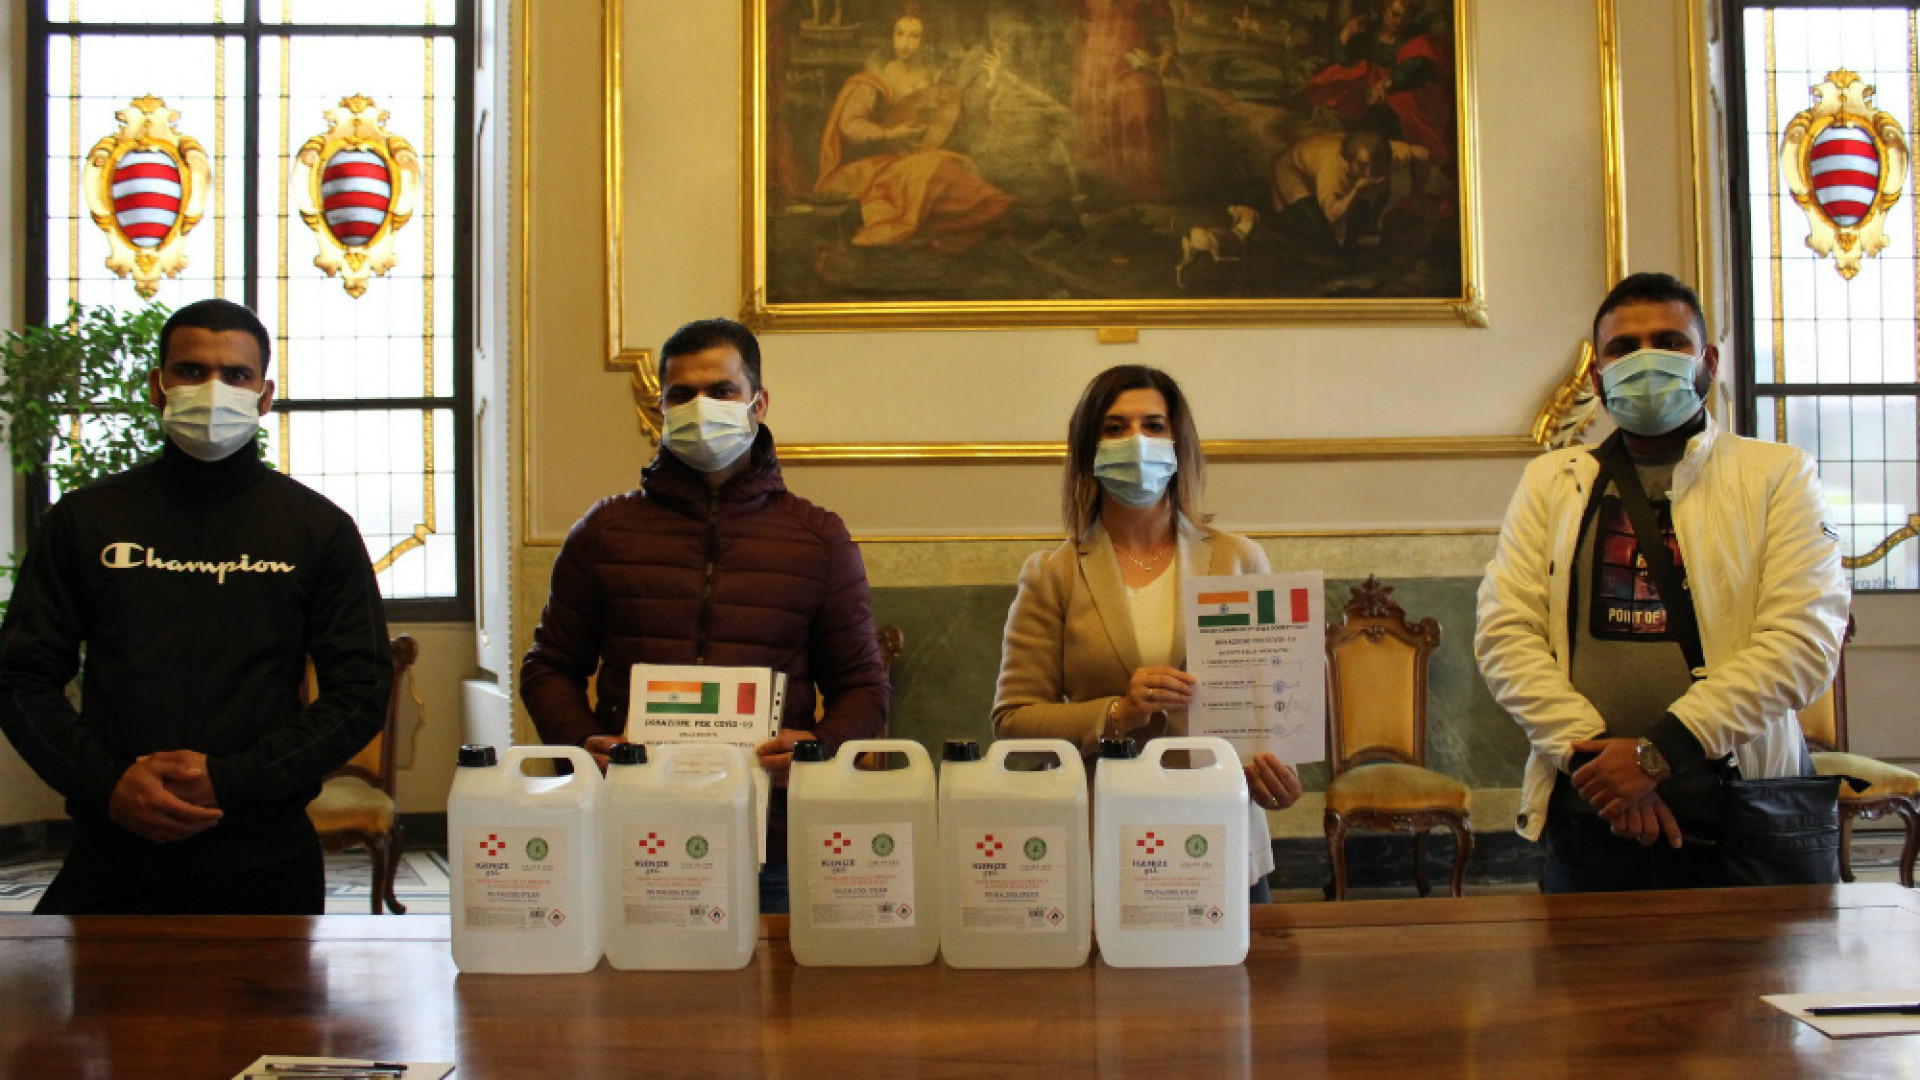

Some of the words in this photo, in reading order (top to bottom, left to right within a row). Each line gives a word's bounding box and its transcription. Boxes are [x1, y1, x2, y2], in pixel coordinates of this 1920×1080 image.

[101, 542, 296, 585] Champion
[645, 719, 691, 728] DONAZIONE
[694, 719, 711, 728] PER
